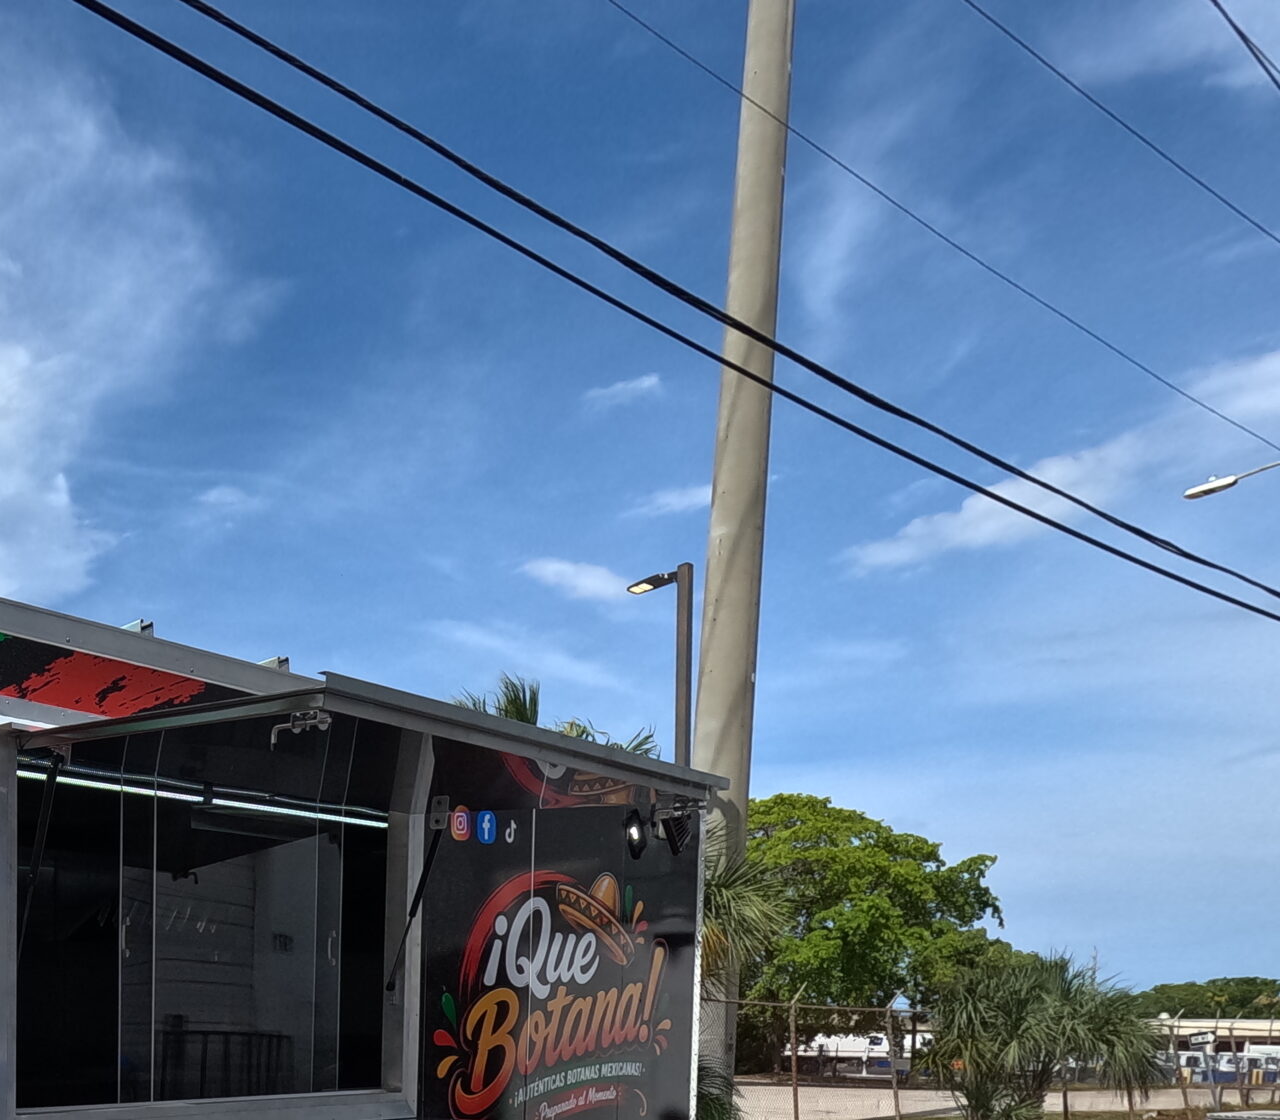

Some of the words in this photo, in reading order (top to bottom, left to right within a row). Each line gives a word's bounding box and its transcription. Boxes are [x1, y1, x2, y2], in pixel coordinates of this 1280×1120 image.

[483, 896, 599, 999] ¡Que
[455, 946, 665, 1115] Botana!
[514, 1074, 565, 1108] ¡AUTÉNTICAS
[566, 1064, 600, 1085] BOTANAS
[600, 1061, 643, 1078] MEXICANAS!
[577, 1091, 587, 1106] al
[586, 1084, 617, 1105] Momento
